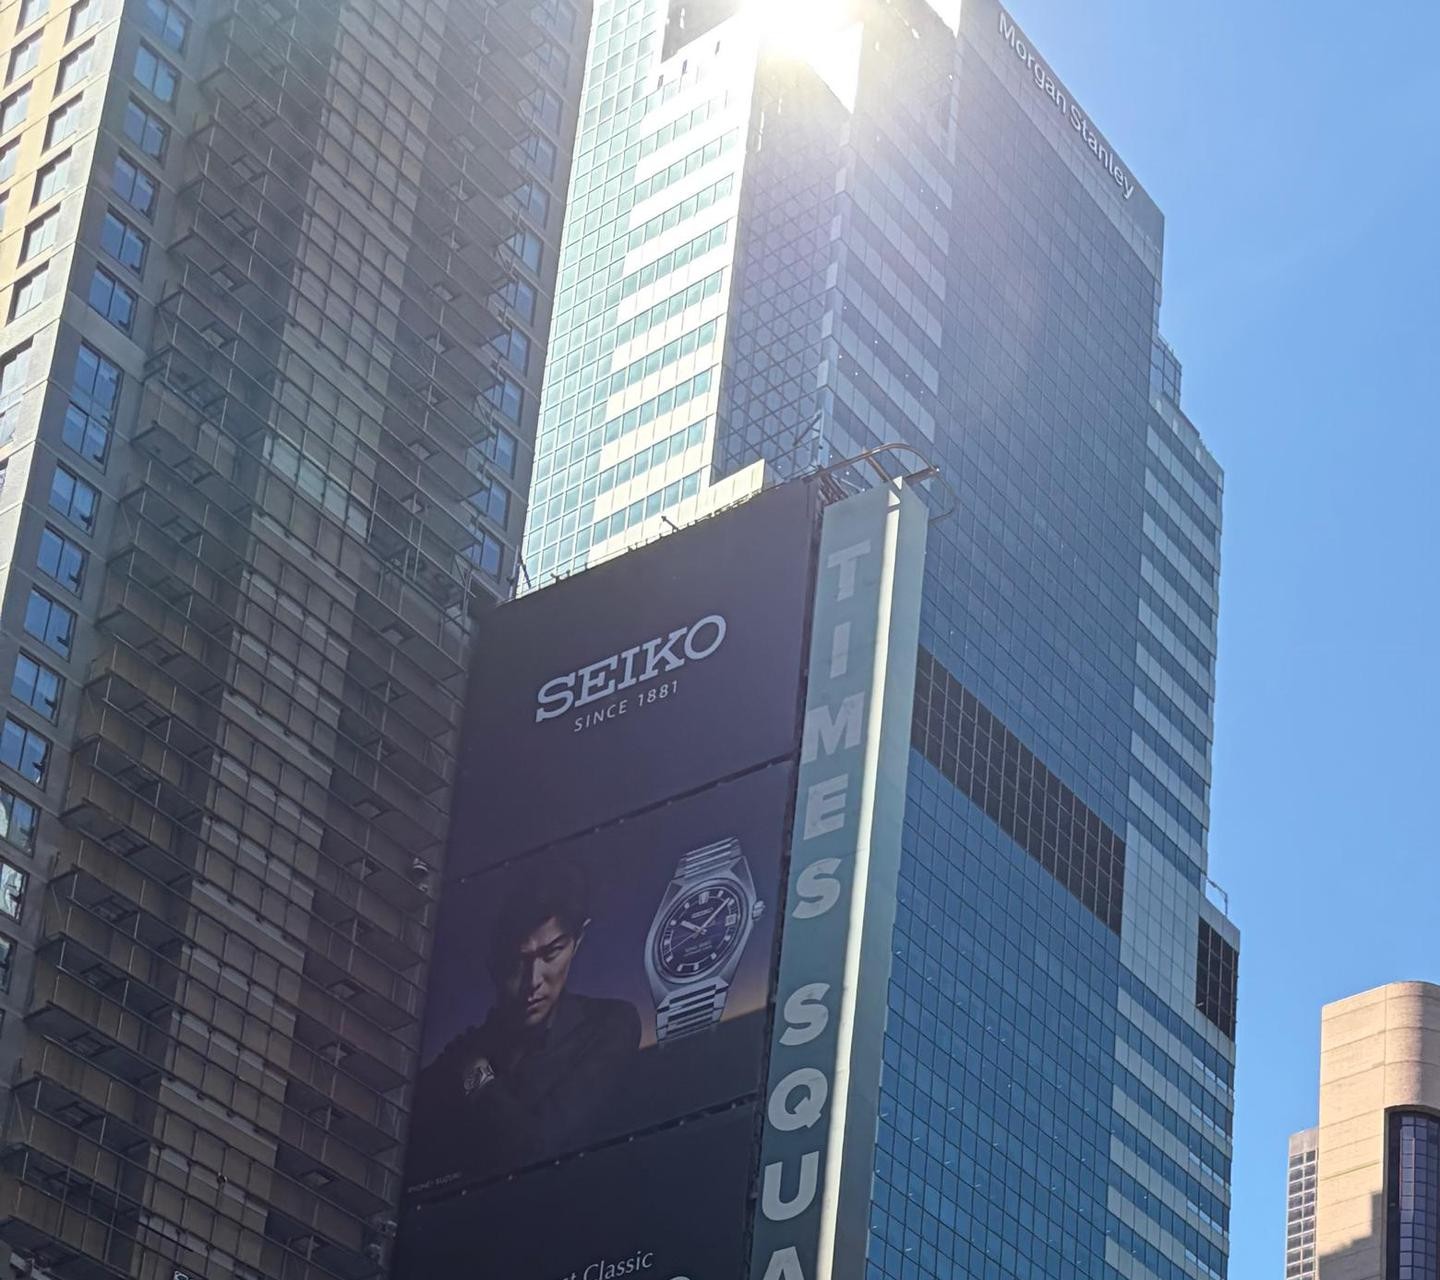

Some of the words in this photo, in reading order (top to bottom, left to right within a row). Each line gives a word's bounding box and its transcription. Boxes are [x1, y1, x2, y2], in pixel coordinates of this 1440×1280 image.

[999, 12, 1067, 115] Morgan
[1069, 104, 1134, 200] Stanley
[536, 614, 727, 722] SEIKO
[573, 701, 628, 733] SINCE
[637, 680, 680, 707] 1881
[791, 540, 870, 919] TIMES
